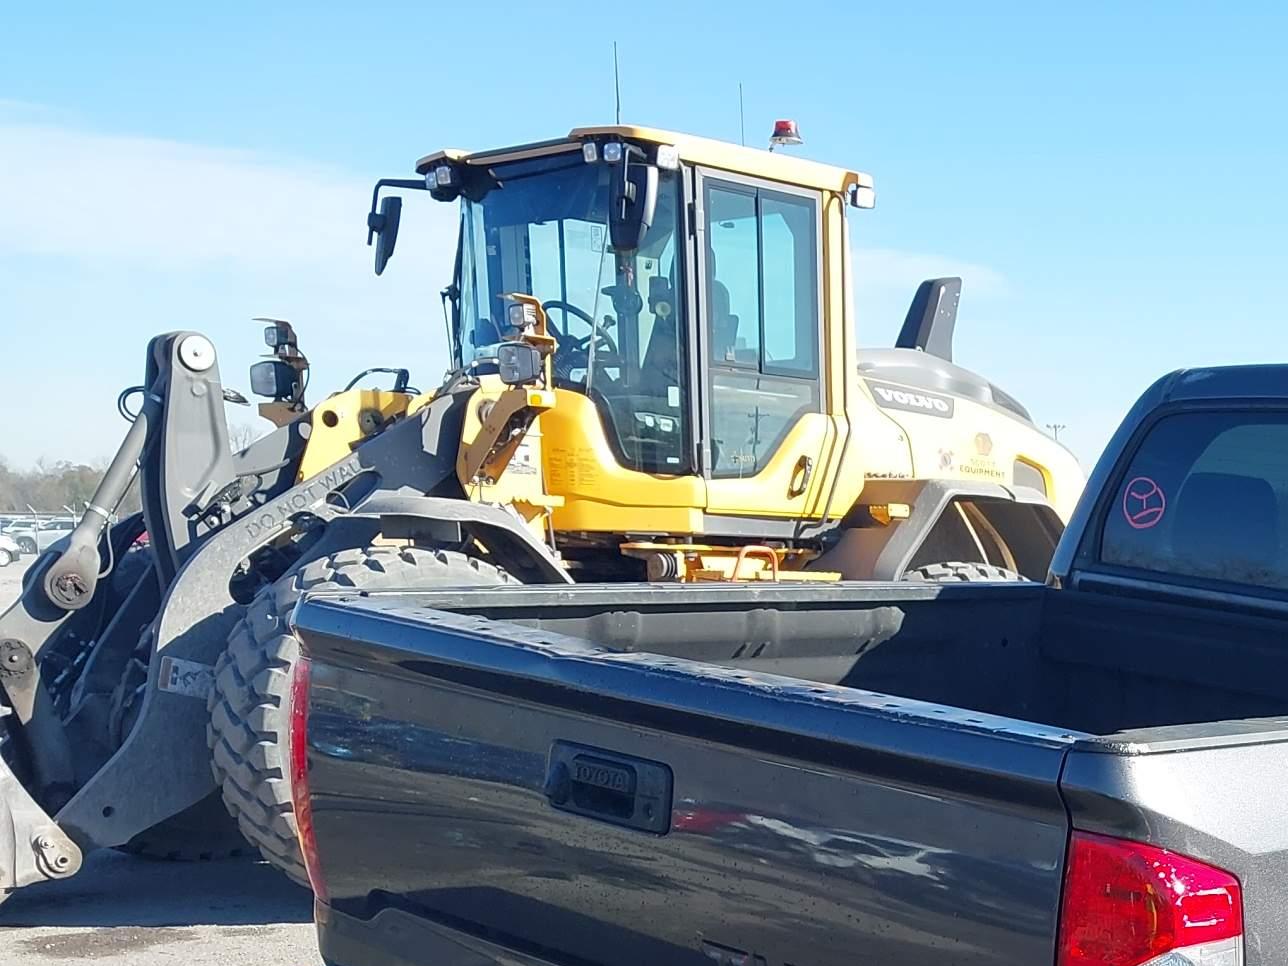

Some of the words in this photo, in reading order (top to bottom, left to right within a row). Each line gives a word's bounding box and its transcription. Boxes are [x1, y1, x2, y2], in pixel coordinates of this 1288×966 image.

[874, 387, 950, 412] VOLVO
[960, 464, 1006, 479] EQUIPMENT
[245, 513, 275, 539] DO
[277, 485, 319, 515] NOT
[574, 764, 629, 789] TOYOTA
